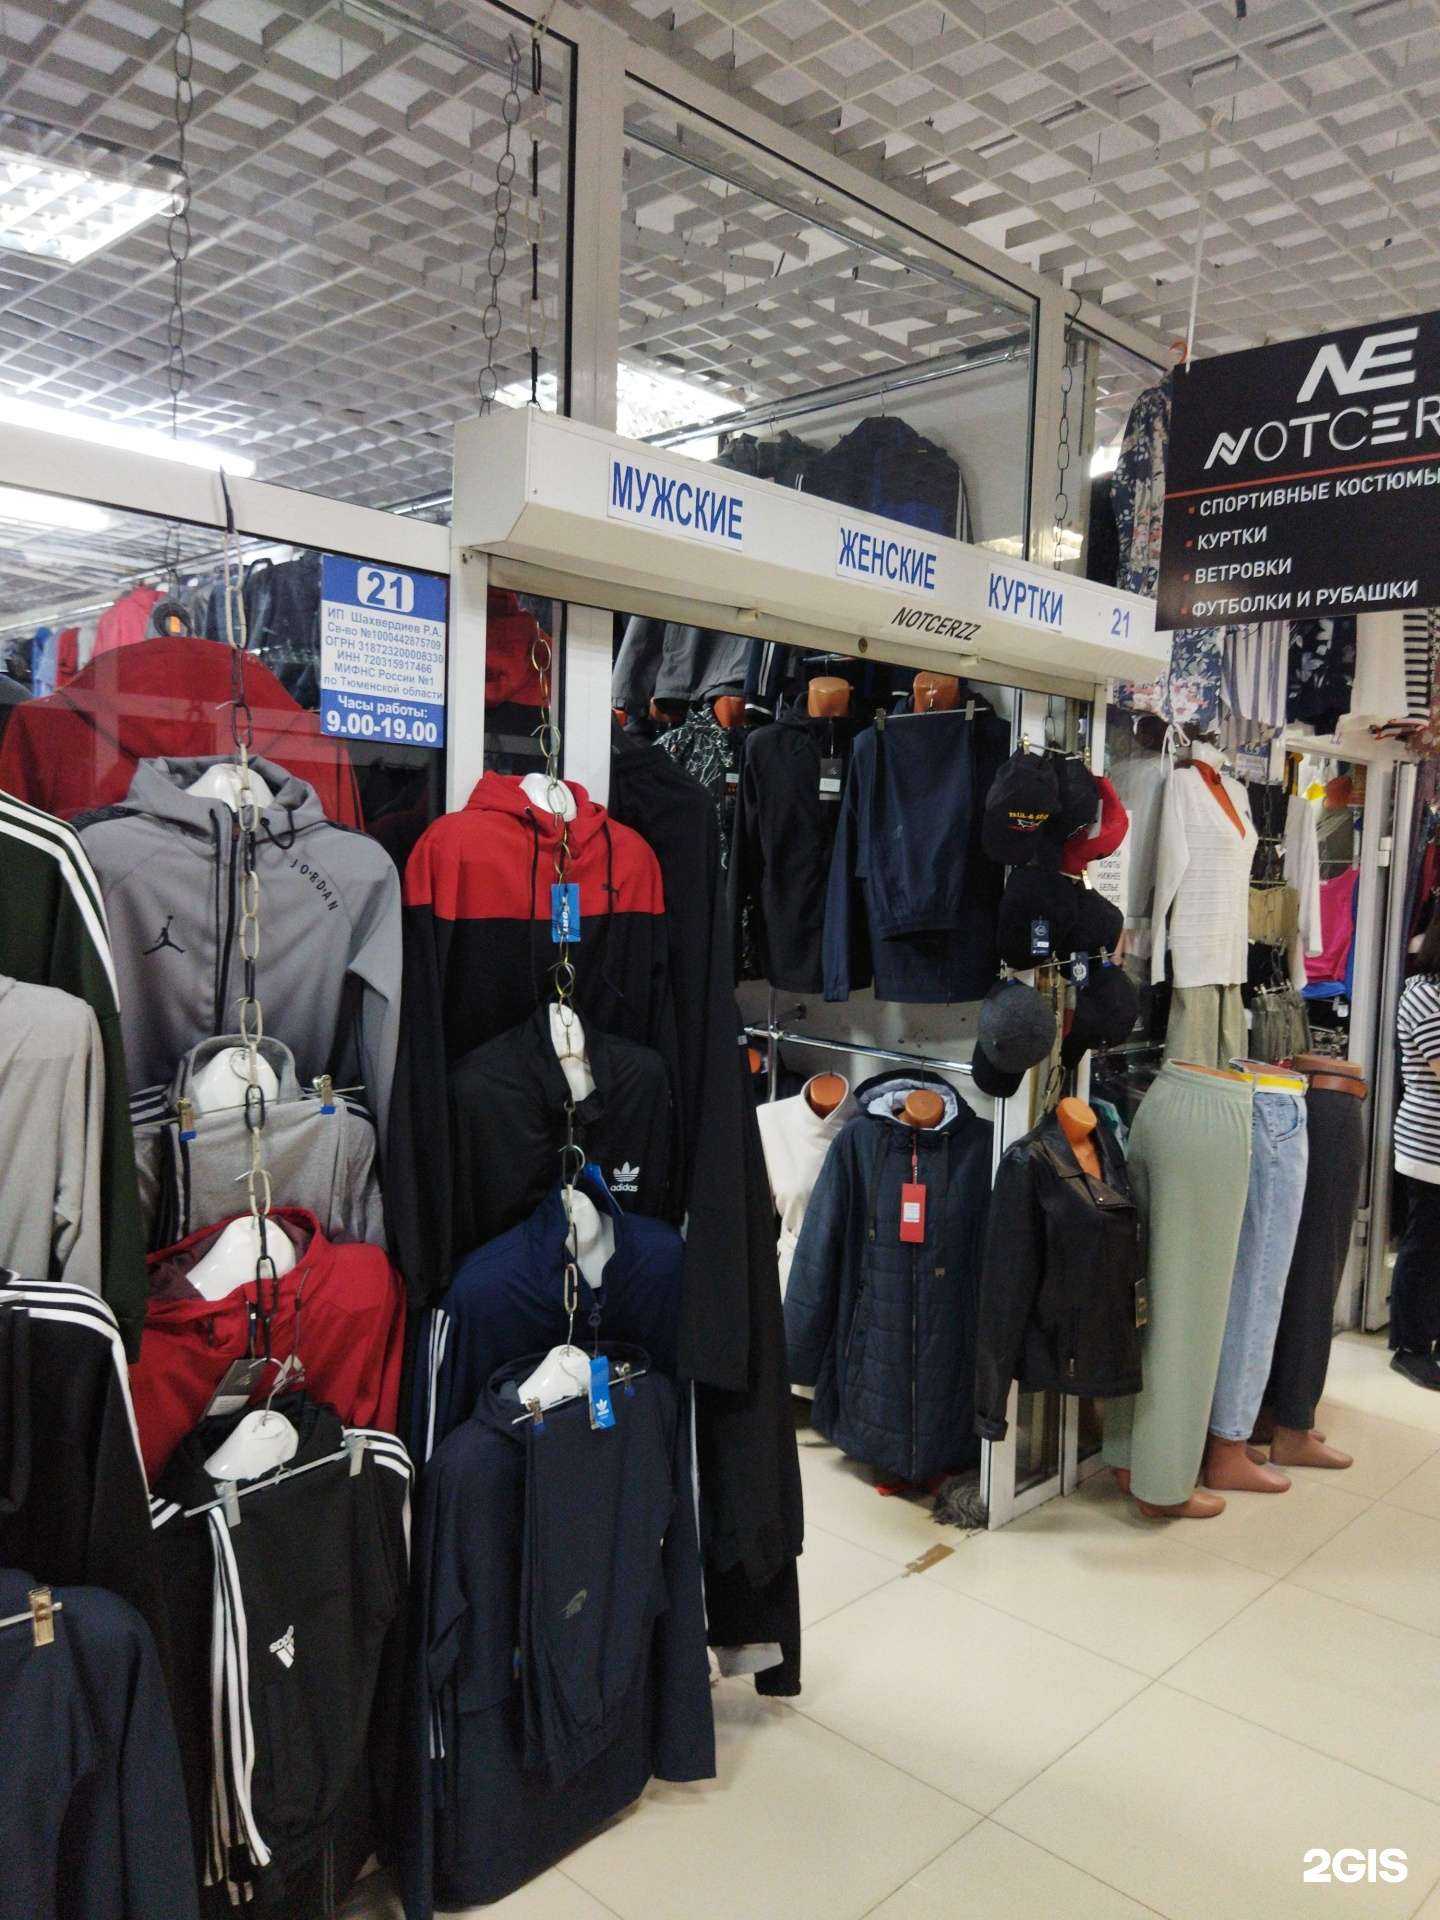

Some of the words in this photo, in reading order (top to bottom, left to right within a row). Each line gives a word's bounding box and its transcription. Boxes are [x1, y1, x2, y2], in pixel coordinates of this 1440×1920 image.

[1200, 481, 1331, 517] СПОРТИВНЫЕ
[612, 462, 743, 540] МУЖСКИЕ
[838, 527, 937, 590] ЖЕНСКИЕ
[988, 573, 1064, 626] КУРТКИ
[1110, 607, 1131, 638] 21
[1197, 526, 1267, 550] КУРТКИ
[1195, 557, 1292, 584] ВЕТРОВКИ
[366, 571, 402, 609] 21
[1192, 592, 1291, 617] ФУТБОЛКИ
[1297, 589, 1311, 607] И
[1316, 579, 1419, 606] РУБАШКИ
[328, 607, 344, 620] ИП
[890, 606, 982, 641] NOTCERZZ
[325, 635, 355, 649] ОГРН
[337, 649, 360, 663] ИНН
[334, 662, 376, 677] МИФНС
[378, 669, 415, 684] России
[323, 676, 337, 685] по
[340, 676, 400, 693] Тюменской
[403, 686, 443, 699] области
[337, 694, 374, 712] Часы
[377, 702, 428, 718] работы:
[326, 710, 438, 742] 9.00-19.00
[610, 1183, 639, 1192] adidas
